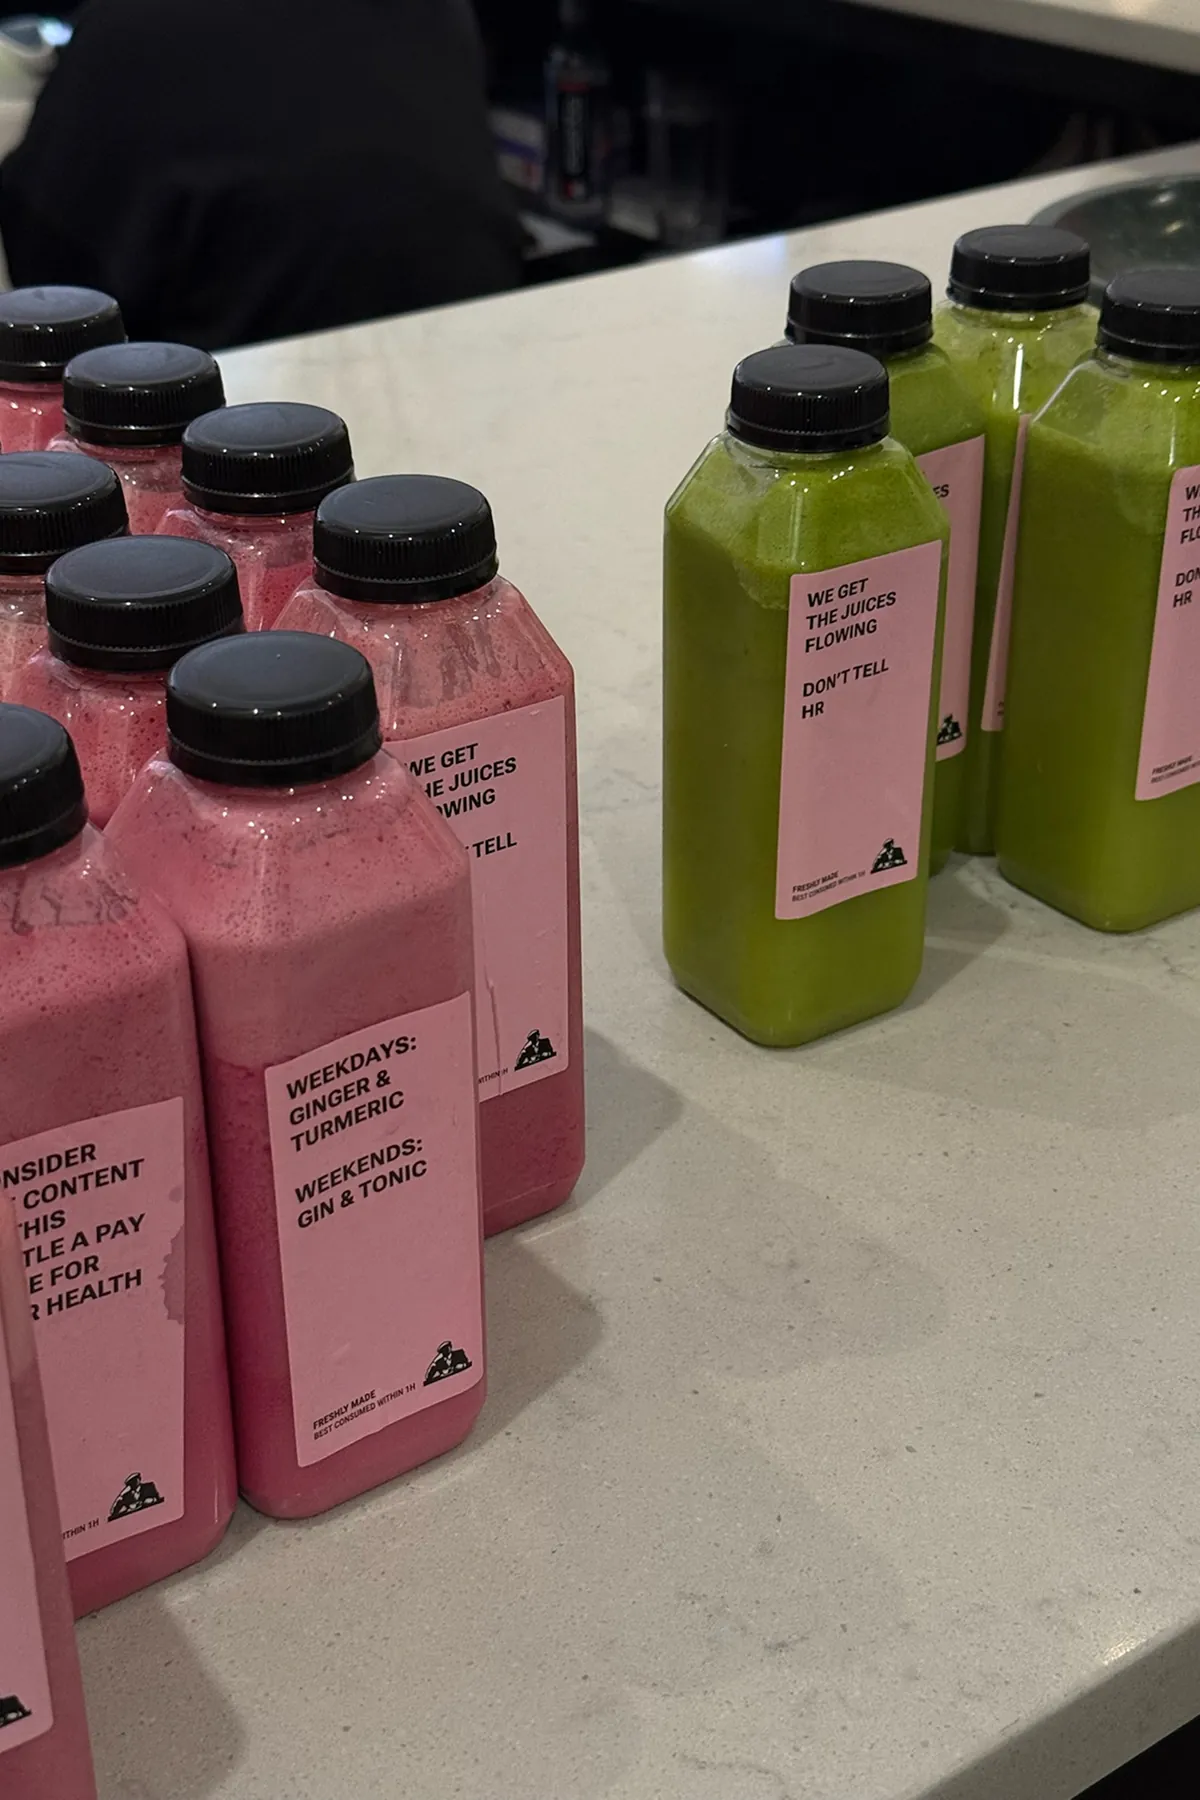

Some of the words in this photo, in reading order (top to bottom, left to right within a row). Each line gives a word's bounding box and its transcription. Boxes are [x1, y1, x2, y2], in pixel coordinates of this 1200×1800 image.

[1185, 485, 1200, 501] W
[806, 608, 838, 630] THE
[840, 591, 897, 620] JUICES
[807, 588, 834, 608] WE
[838, 578, 869, 599] GET
[1173, 590, 1193, 608] HR
[805, 619, 877, 653] FLOWING
[803, 668, 851, 697] DON'T
[852, 658, 889, 680] TELL
[801, 701, 825, 719] HR
[404, 756, 436, 777] WE
[441, 743, 479, 768] GET
[448, 757, 517, 792] JUICES
[472, 832, 518, 858] TELL
[286, 1036, 417, 1100] WEEKDAYS:
[289, 1076, 370, 1125] GINGER
[376, 1069, 391, 1088] &
[290, 1090, 404, 1153] TURMERIC
[0, 1143, 97, 1189] NSIDER
[23, 1158, 145, 1210] CONTENT
[295, 1138, 423, 1204] WEEKENDS:
[297, 1197, 335, 1228] GIN
[340, 1189, 355, 1208] &
[358, 1159, 427, 1199] TONIC
[18, 1209, 66, 1239] HIS
[70, 1231, 90, 1252] A
[95, 1212, 146, 1244] PAY
[50, 1255, 100, 1287] FOR
[46, 1268, 142, 1316] HEALTH
[313, 1403, 349, 1430] FRESHLY
[351, 1389, 377, 1410] MADE
[313, 1425, 333, 1440] BEST
[334, 1403, 376, 1429] CONSUMED
[377, 1389, 404, 1407] WITHIN
[405, 1382, 416, 1394] 1H
